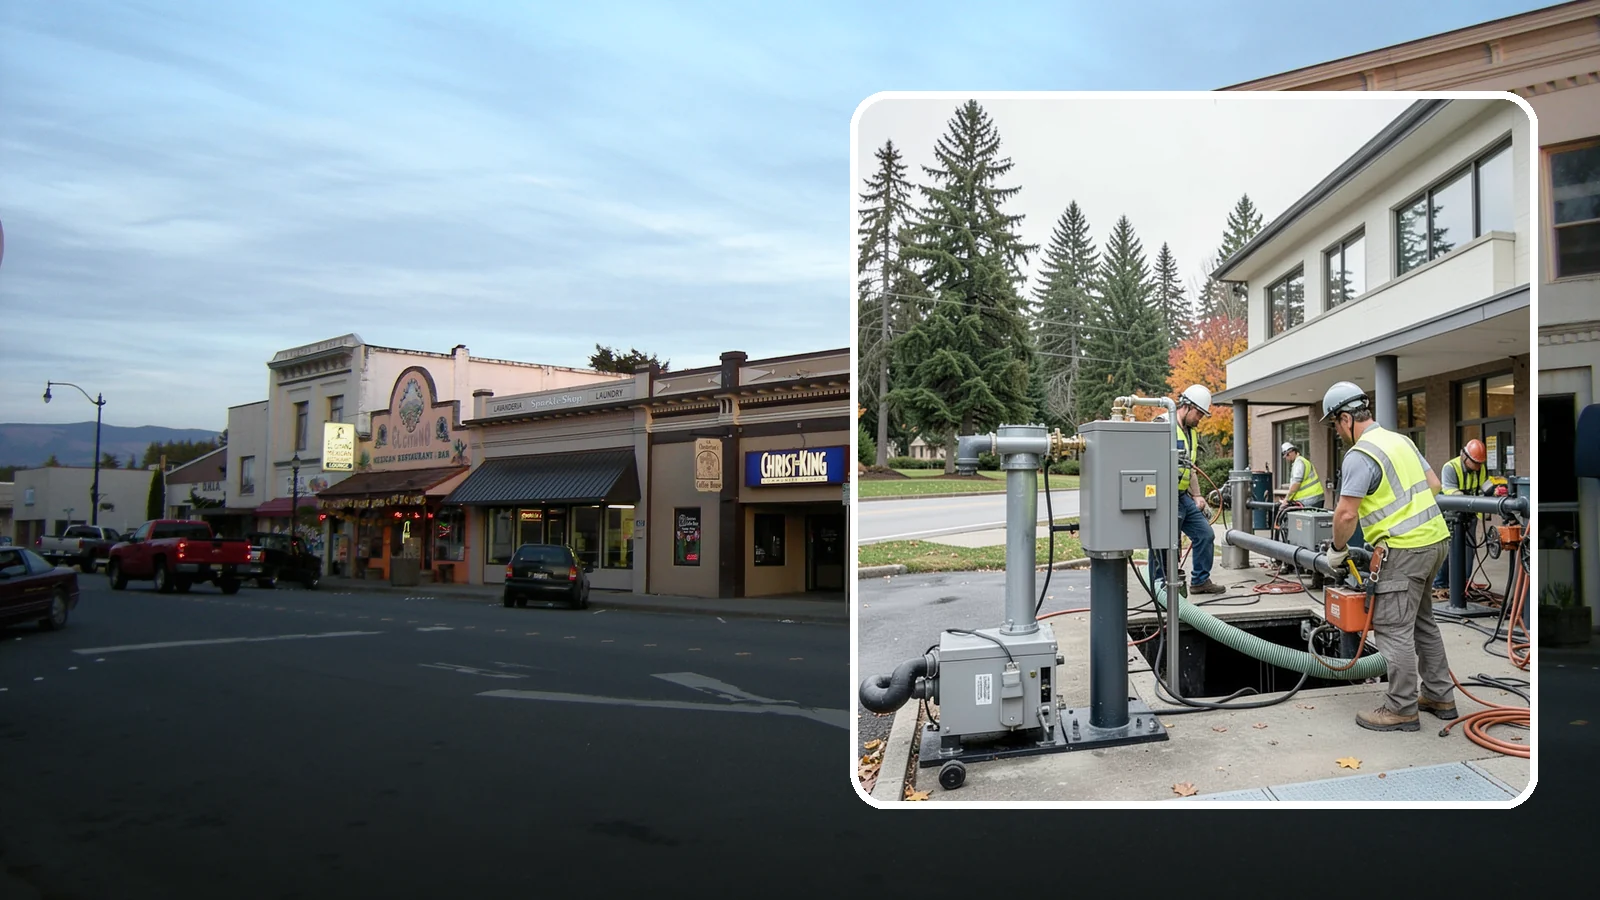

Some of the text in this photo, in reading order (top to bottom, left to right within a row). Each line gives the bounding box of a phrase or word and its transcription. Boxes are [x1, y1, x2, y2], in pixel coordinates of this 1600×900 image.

[595, 388, 624, 400] LAUNDRY
[493, 402, 523, 413] LAVANDERIA
[531, 394, 583, 409] Sparkle Shop
[373, 449, 450, 465] MEXICAN RESTAURANT BAR
[760, 452, 797, 478] CHRIST
[799, 450, 828, 477] KING
[696, 480, 722, 489] Coffee House
